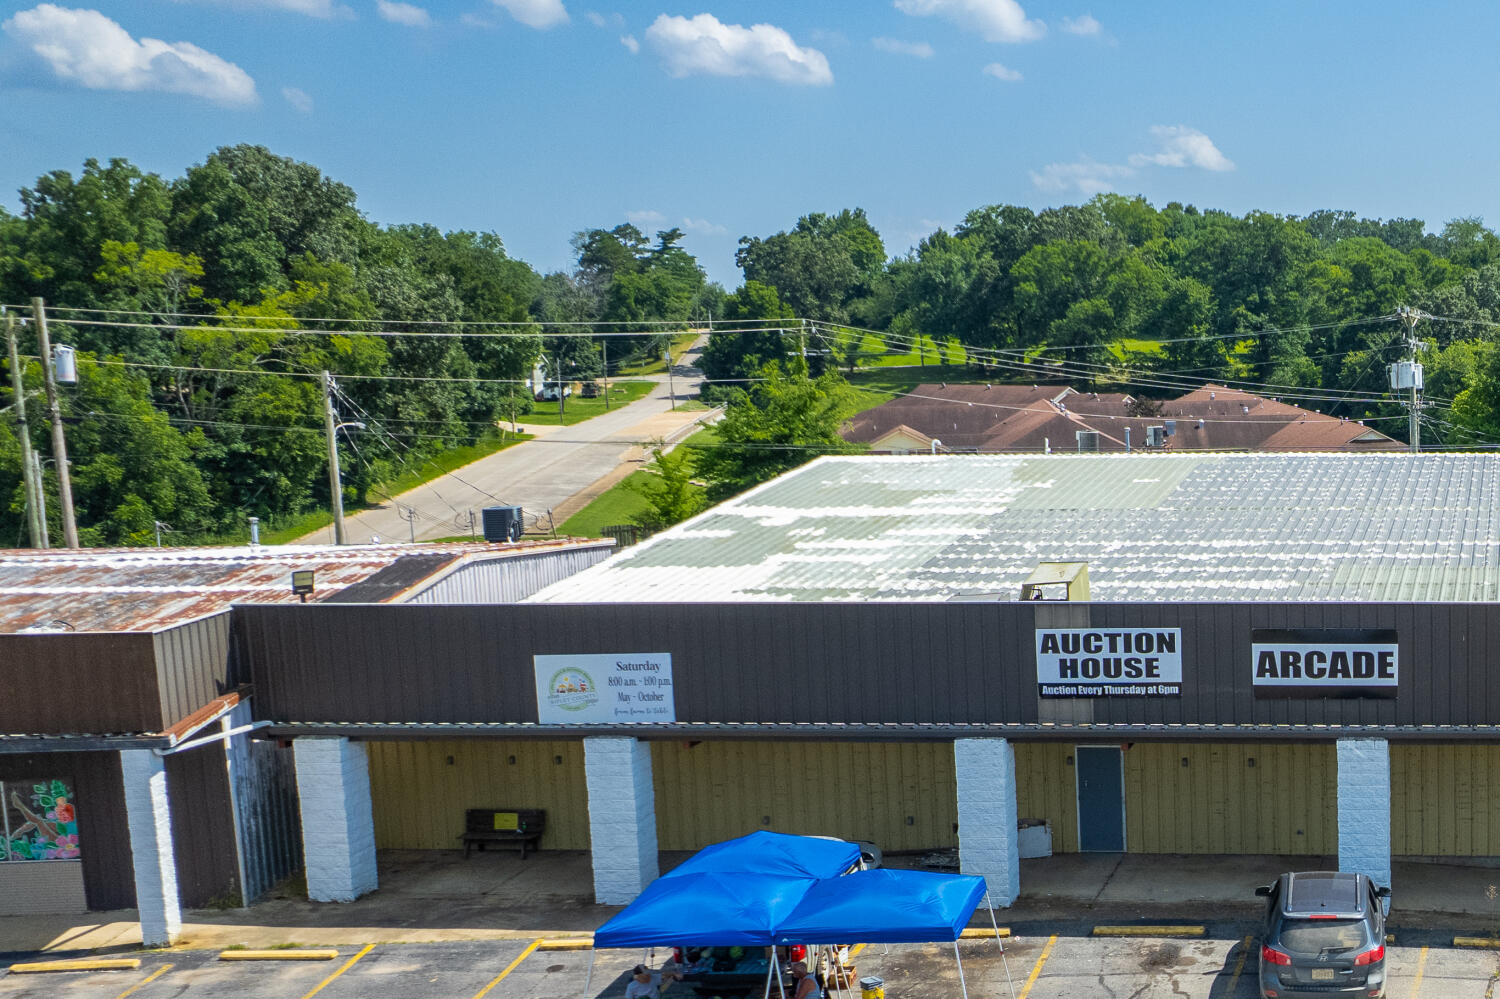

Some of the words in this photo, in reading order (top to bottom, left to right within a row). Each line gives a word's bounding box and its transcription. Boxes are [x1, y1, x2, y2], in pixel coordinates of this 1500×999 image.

[1040, 632, 1177, 654] AUCTION
[616, 660, 661, 673] Saturday
[1059, 657, 1161, 679] HOUSE
[1256, 650, 1395, 679] ARCADE
[618, 691, 631, 704] May
[638, 691, 665, 702] October
[1041, 685, 1076, 696] Auction
[1078, 685, 1102, 698] Every
[1103, 685, 1146, 697] Thursday
[1147, 686, 1157, 696] at
[1158, 685, 1179, 697] 6pm
